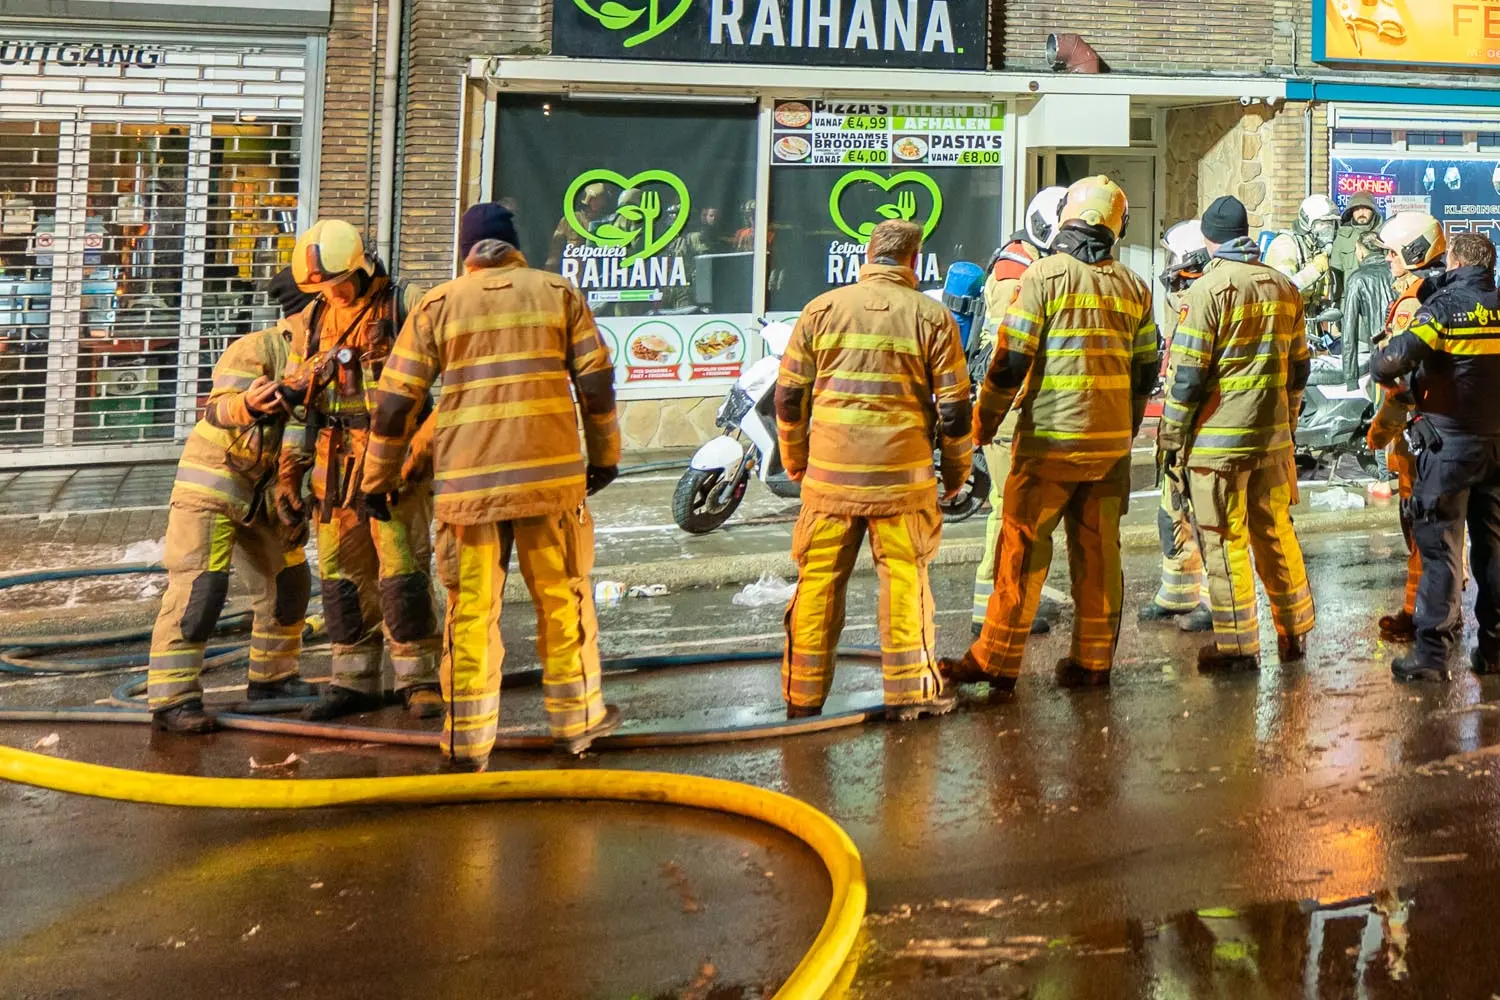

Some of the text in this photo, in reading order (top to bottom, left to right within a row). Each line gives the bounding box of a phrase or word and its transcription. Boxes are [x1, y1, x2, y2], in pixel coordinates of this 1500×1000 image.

[0, 40, 161, 69] UITGANG
[815, 100, 888, 115] PIZZA'S
[896, 105, 967, 117] ALLEEN
[815, 116, 887, 130] VANAF €4,99
[903, 118, 990, 130] AFHALEN
[815, 132, 888, 140] SURINAAMSE
[931, 135, 1002, 149] PASTA'S
[814, 139, 889, 149] BROODJE'S
[814, 155, 841, 164] VANAF
[848, 151, 887, 163] €4,00
[932, 151, 999, 164] VANAF €8,00
[1340, 177, 1393, 194] SCHOENEN
